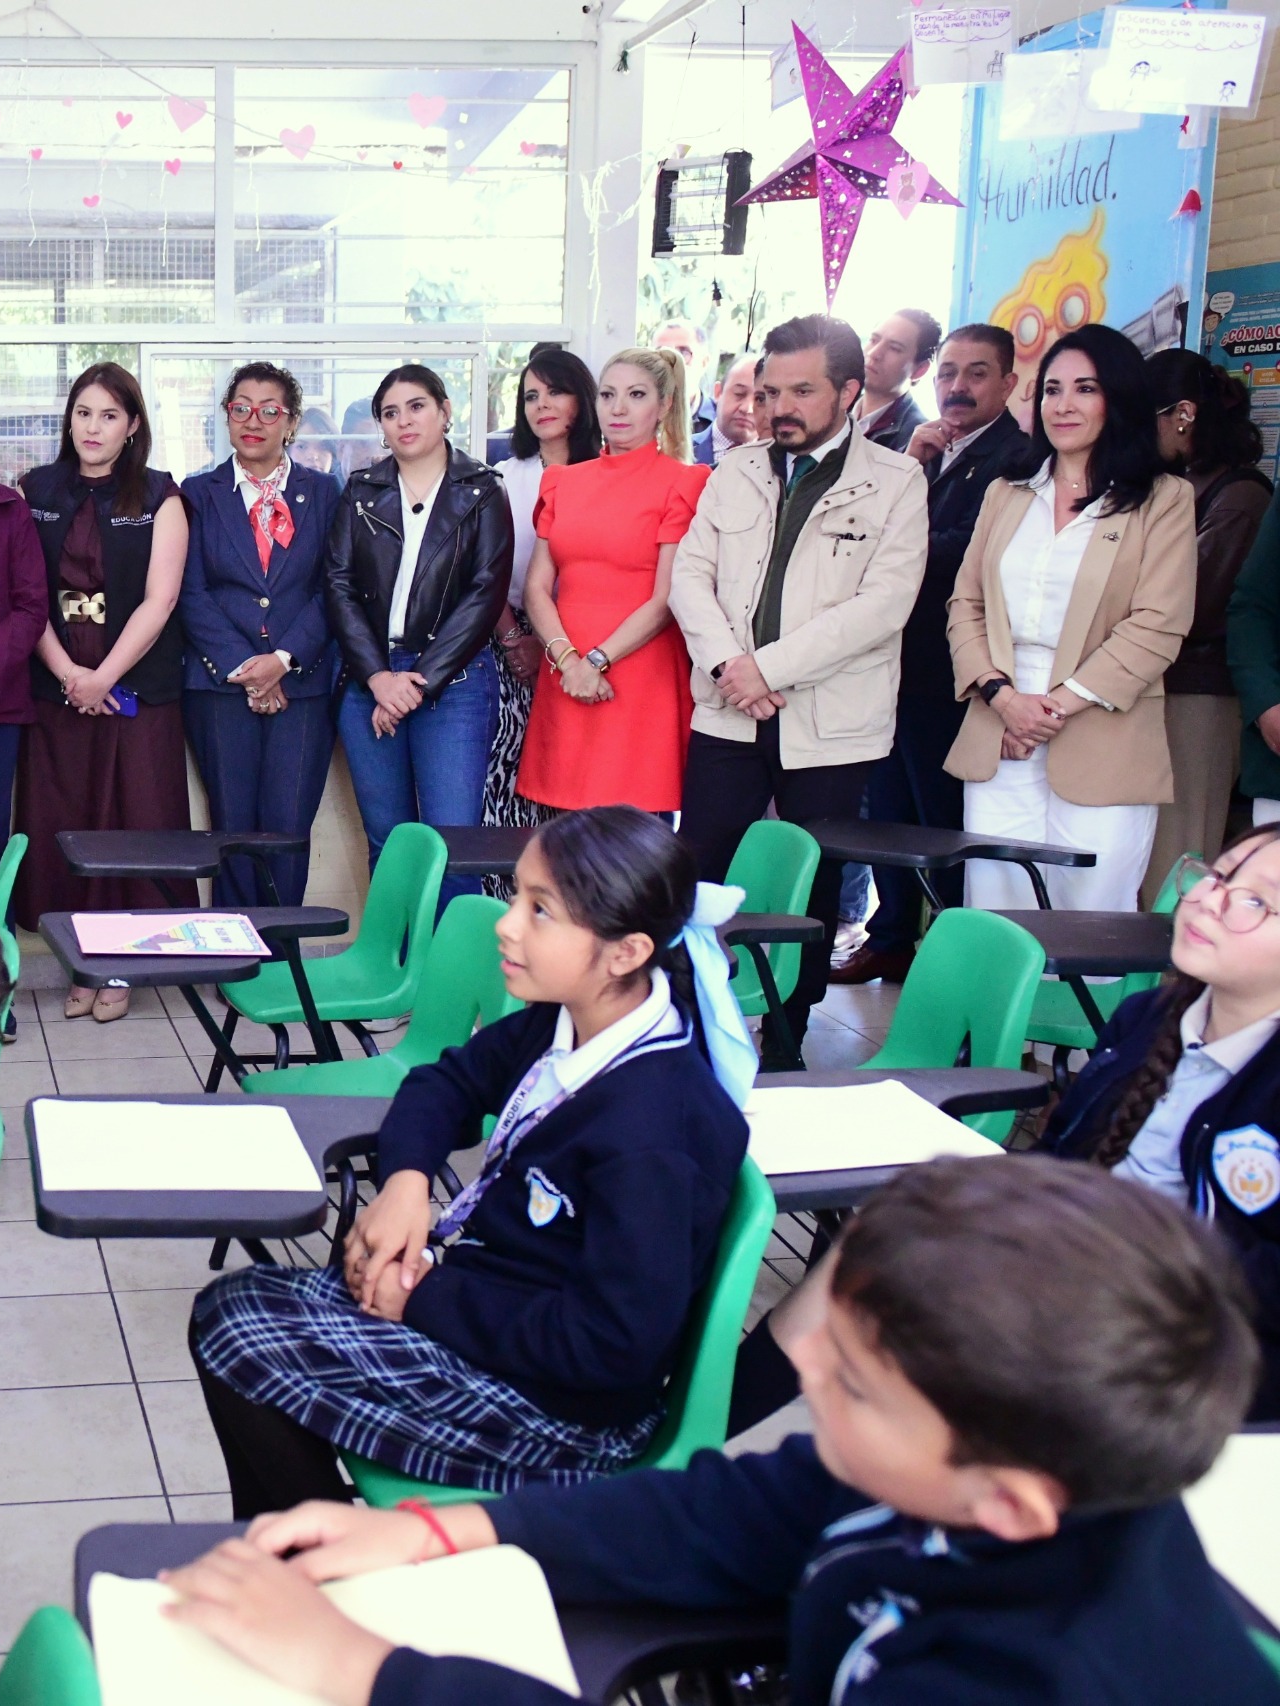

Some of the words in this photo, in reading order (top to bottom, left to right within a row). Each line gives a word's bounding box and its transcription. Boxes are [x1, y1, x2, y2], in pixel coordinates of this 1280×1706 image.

[1171, 19, 1192, 28] con
[1234, 345, 1246, 355] EN
[1248, 342, 1274, 354] CASO
